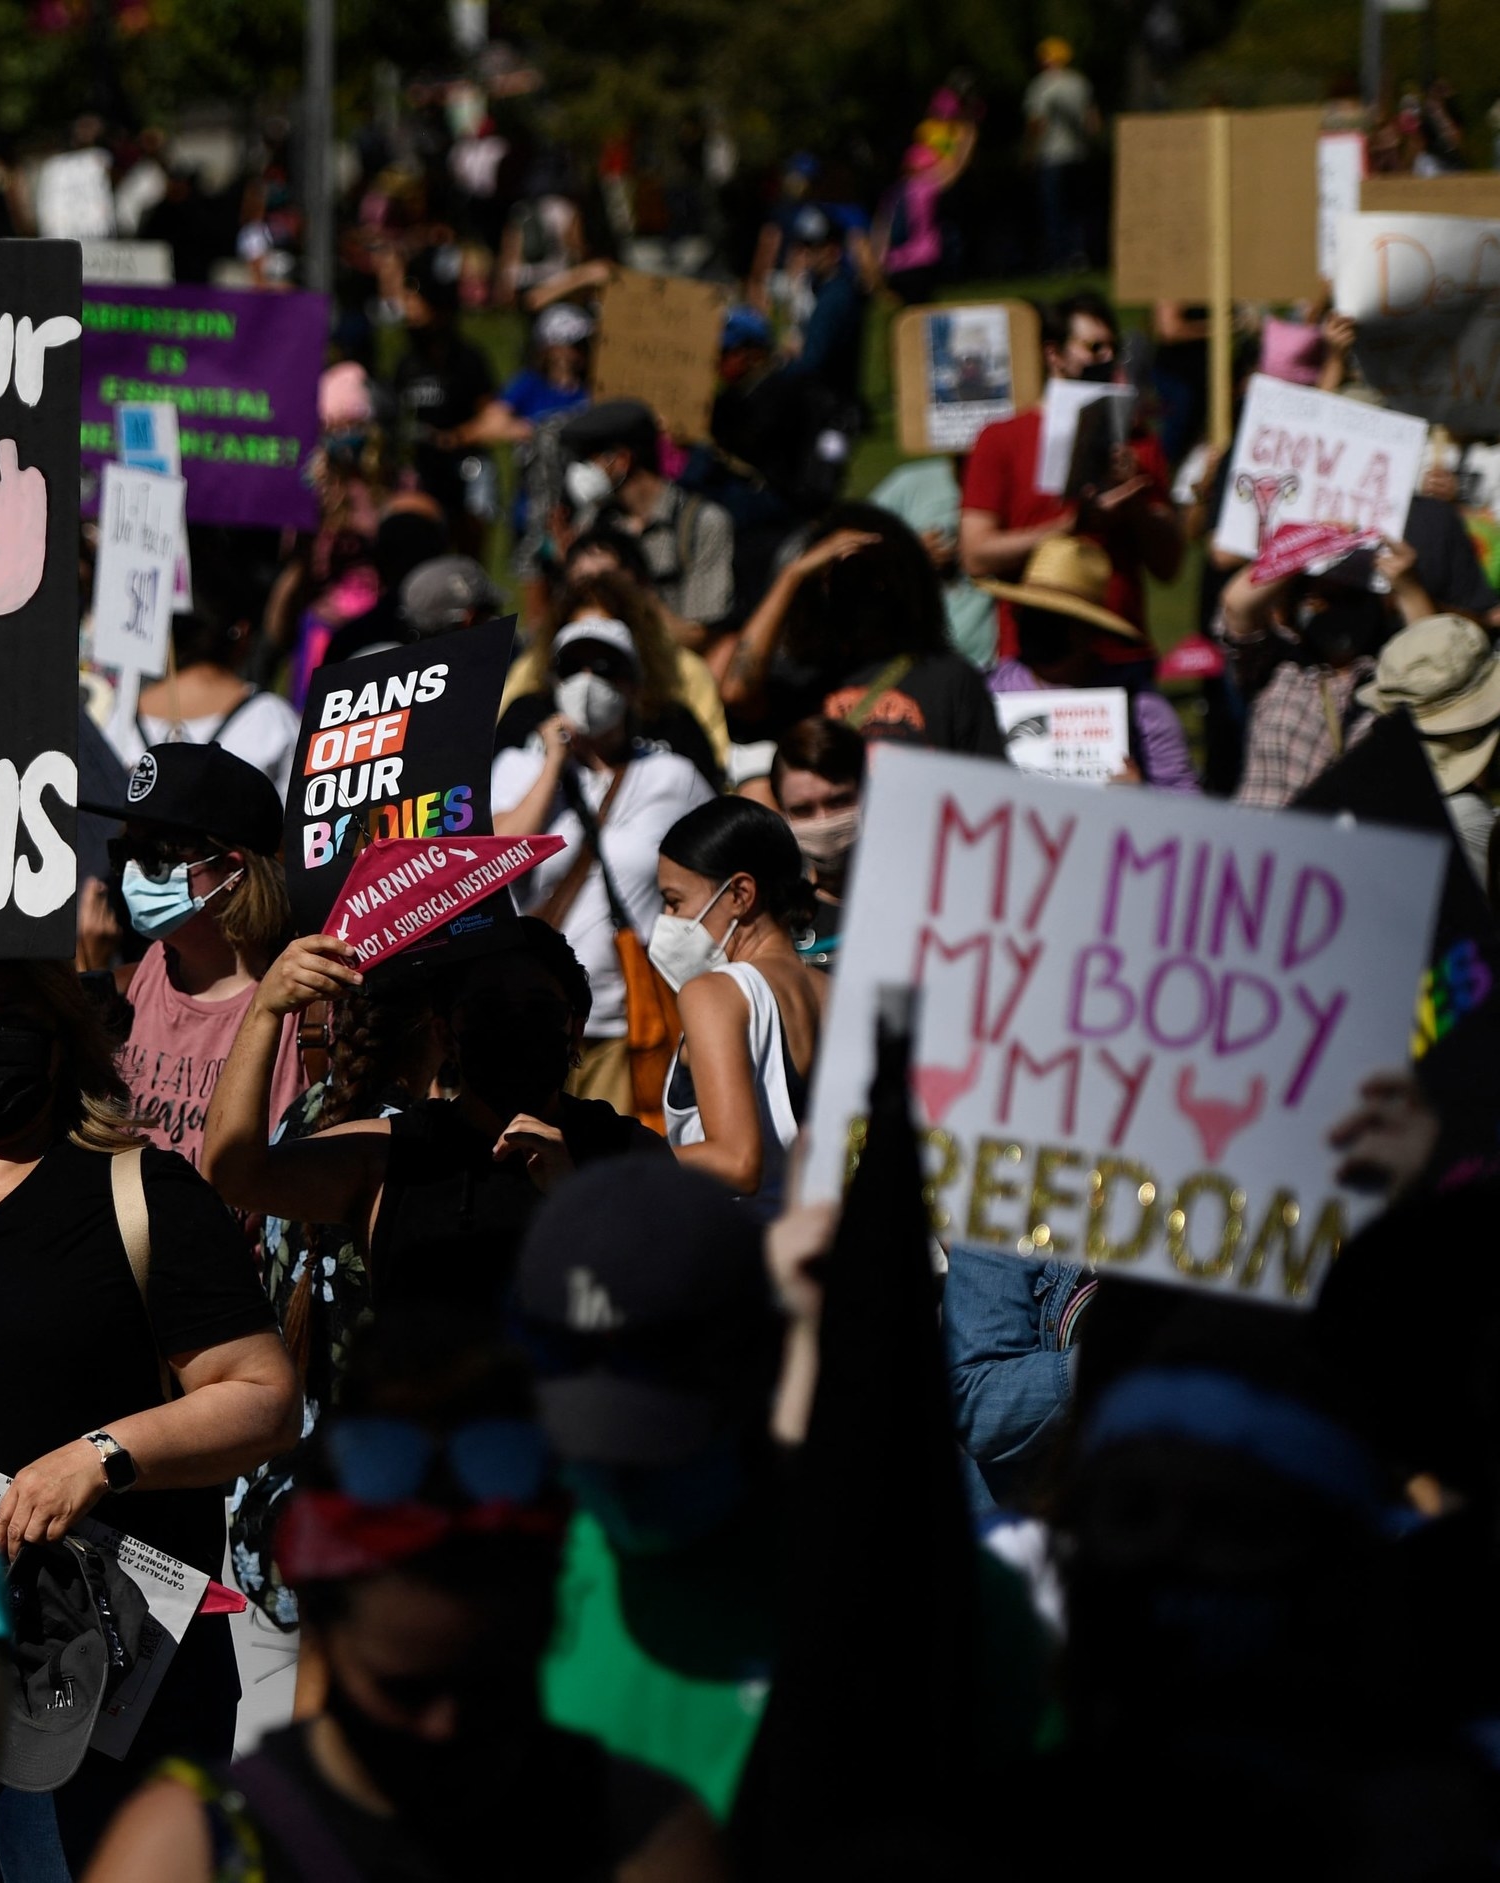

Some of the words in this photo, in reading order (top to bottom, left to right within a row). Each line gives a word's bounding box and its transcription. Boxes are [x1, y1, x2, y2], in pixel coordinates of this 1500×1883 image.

[320, 663, 449, 729] BANS
[311, 713, 403, 771] OFF
[304, 756, 404, 816] OUR
[346, 844, 447, 919] WARNING
[353, 933, 385, 963] NOT
[383, 927, 398, 945] A
[394, 889, 459, 937] SURGICAL
[454, 839, 536, 905] INSTRUMENT
[930, 794, 1078, 932] MY
[1101, 826, 1346, 971] MIND
[913, 923, 1044, 1045] MY
[1069, 942, 1350, 1108] BODY
[998, 1038, 1152, 1148] MY
[134, 1562, 185, 1591] CAPITALIST
[138, 1553, 170, 1573] WOMEN
[155, 1551, 183, 1569] CLASS
[171, 1570, 185, 1580] ON
